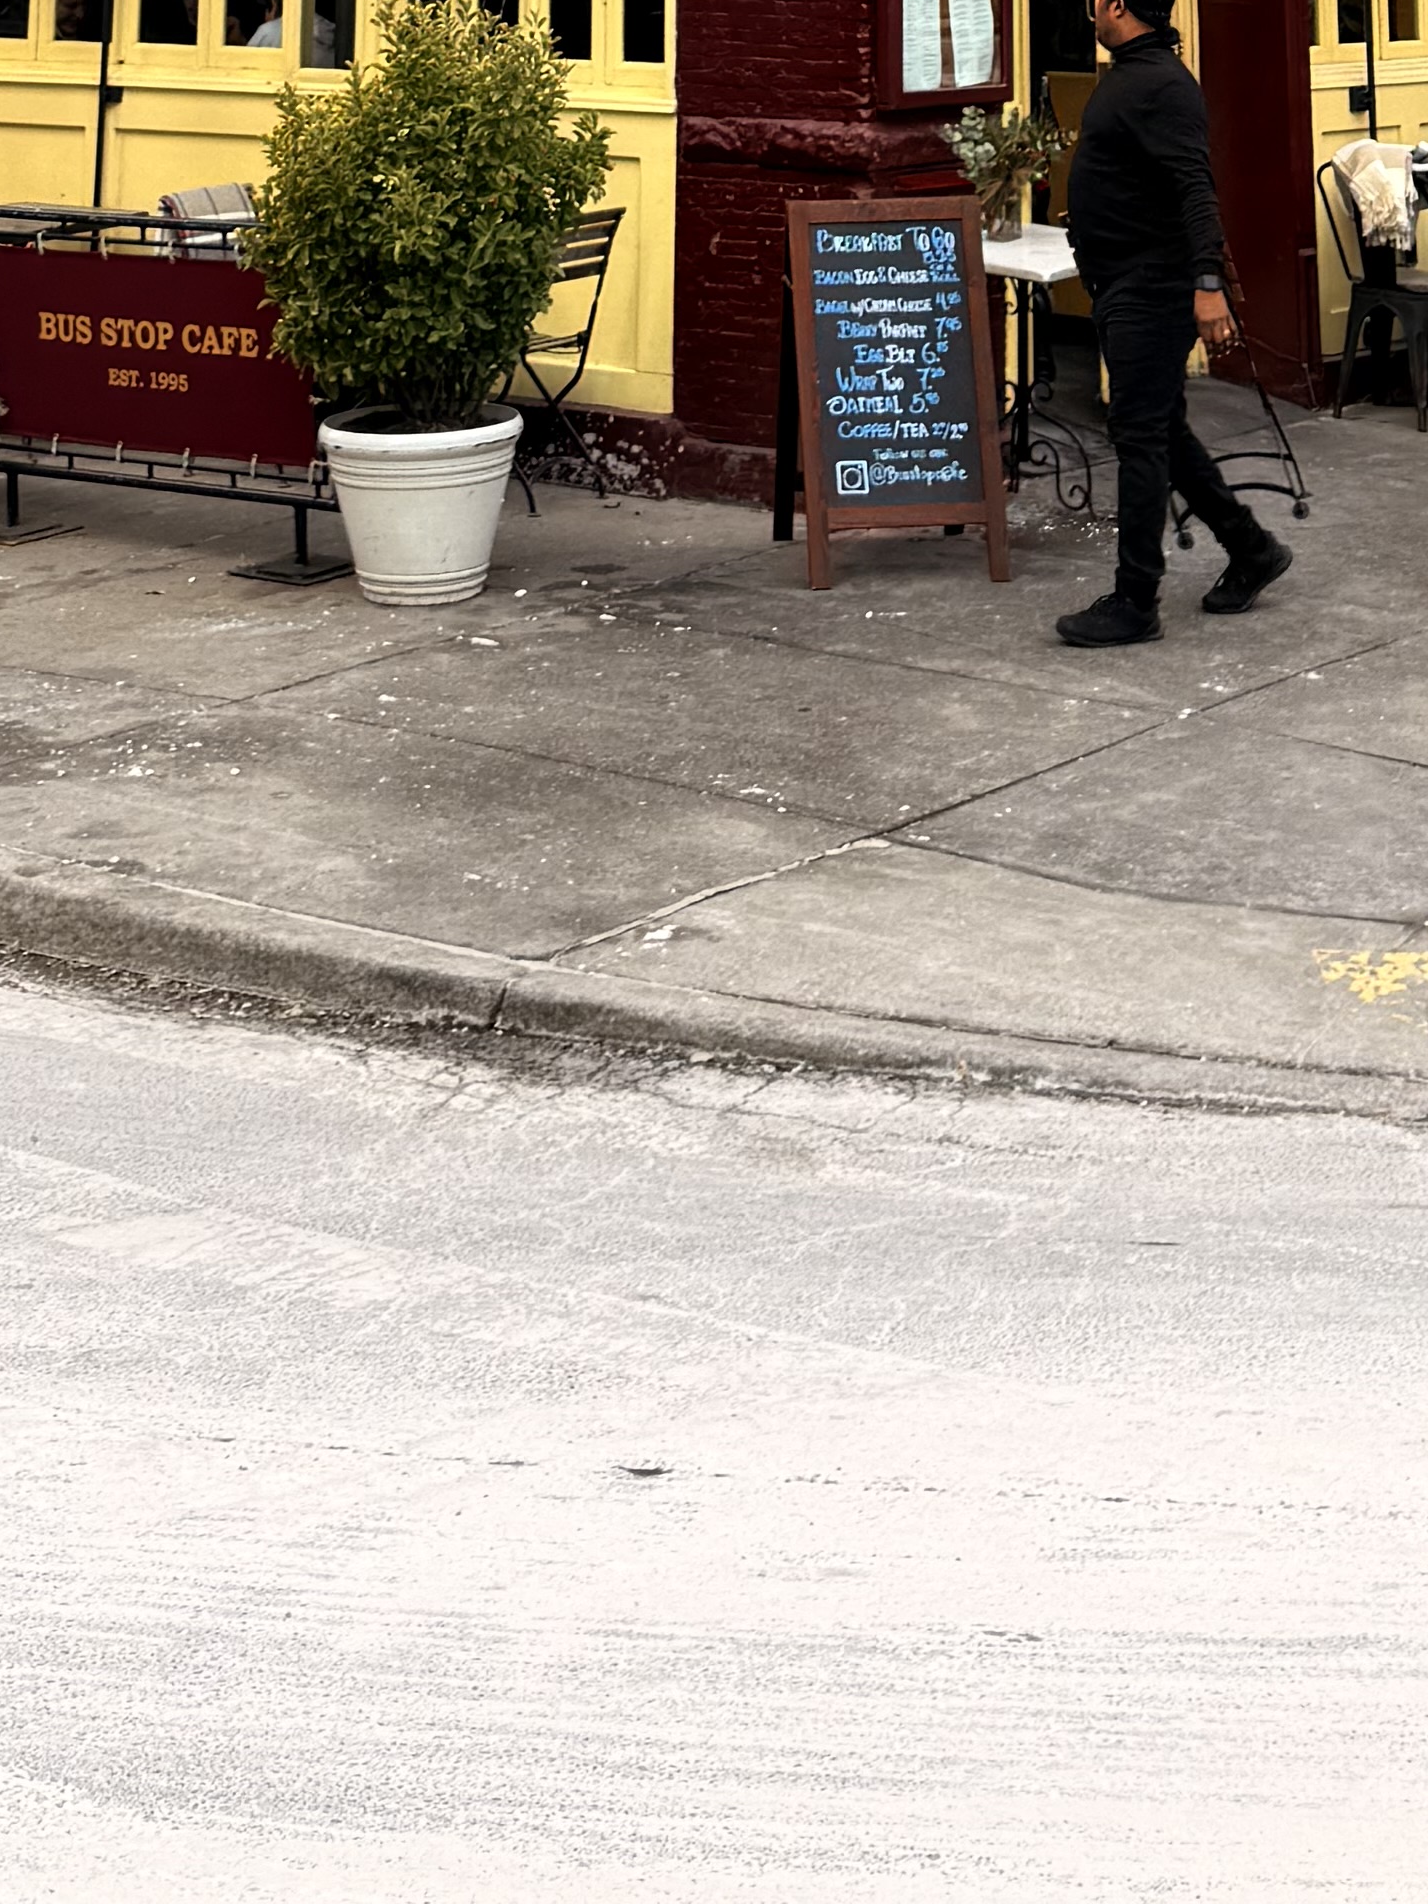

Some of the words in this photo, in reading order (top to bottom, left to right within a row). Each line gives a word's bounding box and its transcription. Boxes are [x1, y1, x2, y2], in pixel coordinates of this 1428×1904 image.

[38, 311, 92, 344] BUS
[100, 317, 174, 350] STOP
[181, 324, 260, 358] CAFE
[108, 368, 145, 388] EST.
[149, 372, 189, 392] 1995
